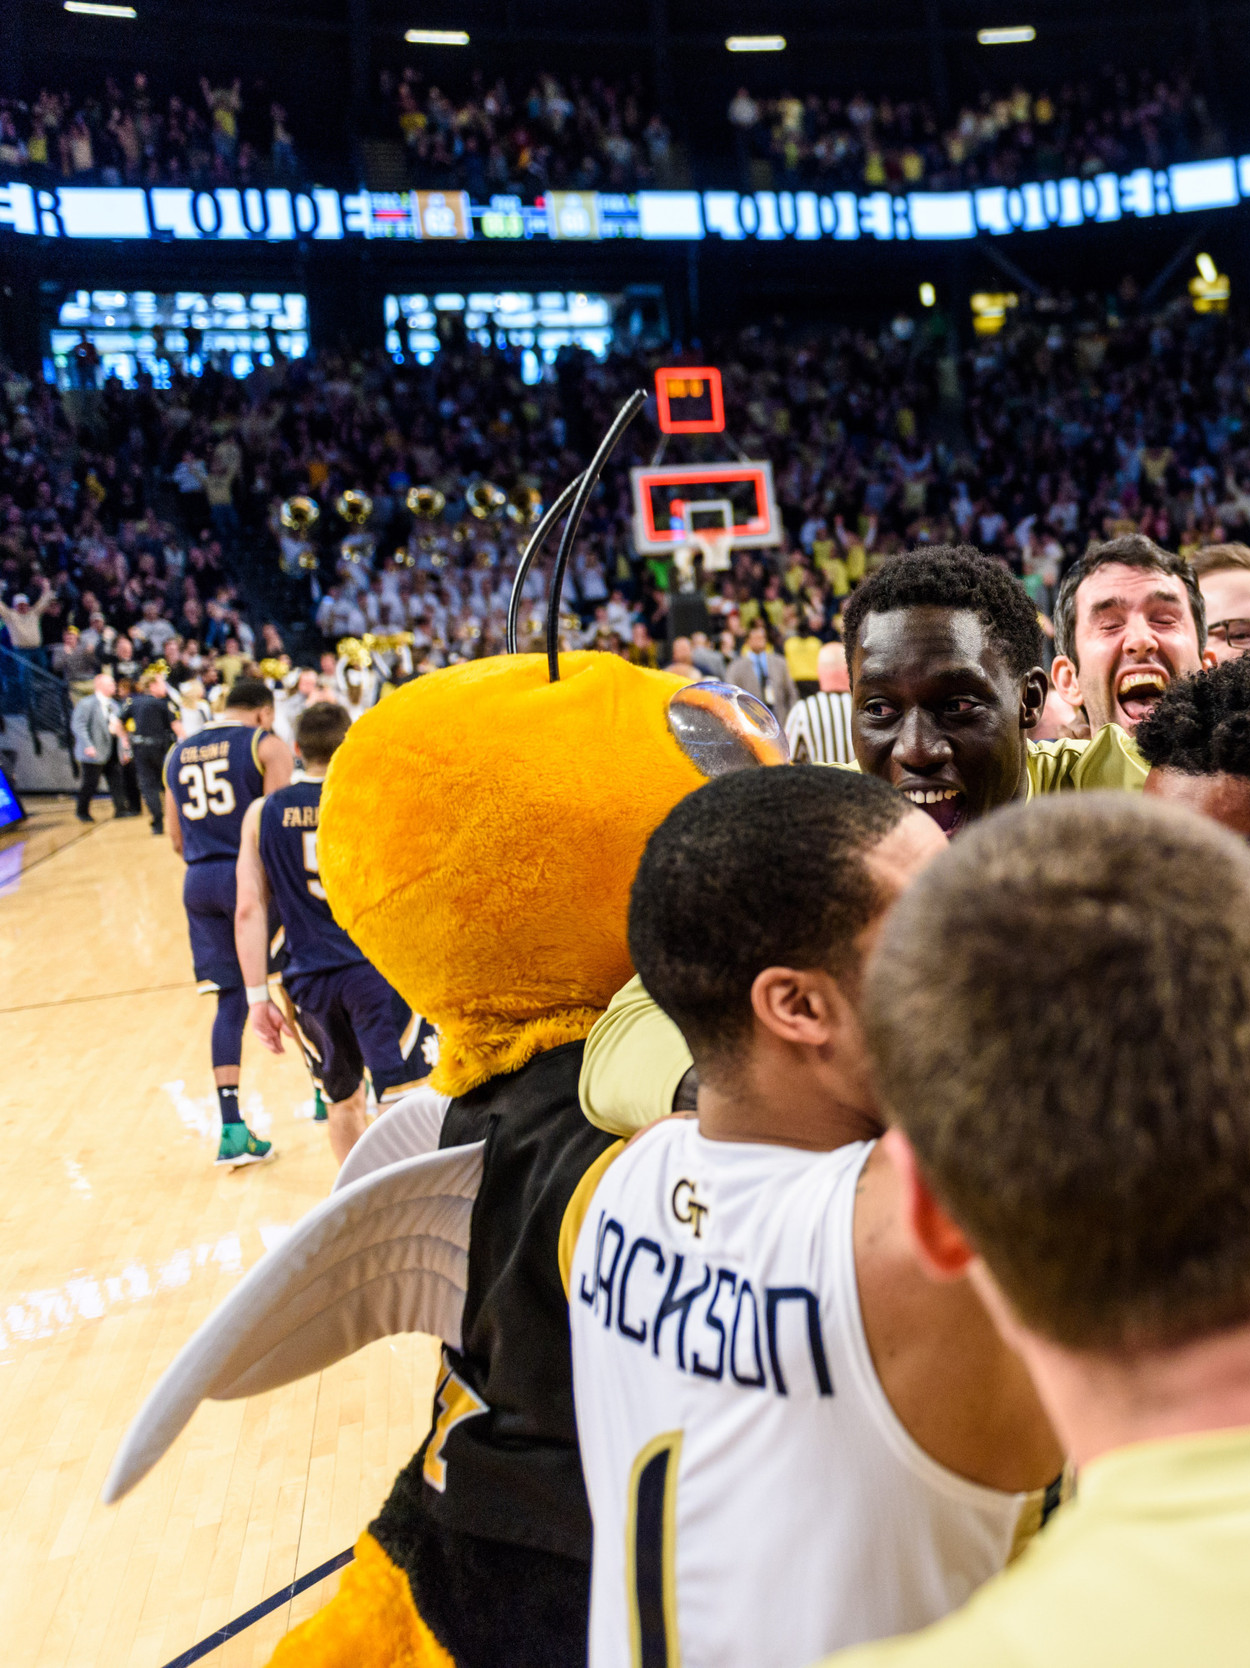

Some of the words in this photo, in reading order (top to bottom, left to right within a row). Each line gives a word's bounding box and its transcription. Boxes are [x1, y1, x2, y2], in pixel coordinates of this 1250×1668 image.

[699, 190, 914, 240] LOUDER
[972, 167, 1176, 238] LOUDER
[178, 758, 236, 821] 35
[672, 1177, 709, 1240] GT
[580, 1208, 835, 1397] JACKSON
[625, 1429, 683, 1668] 1
